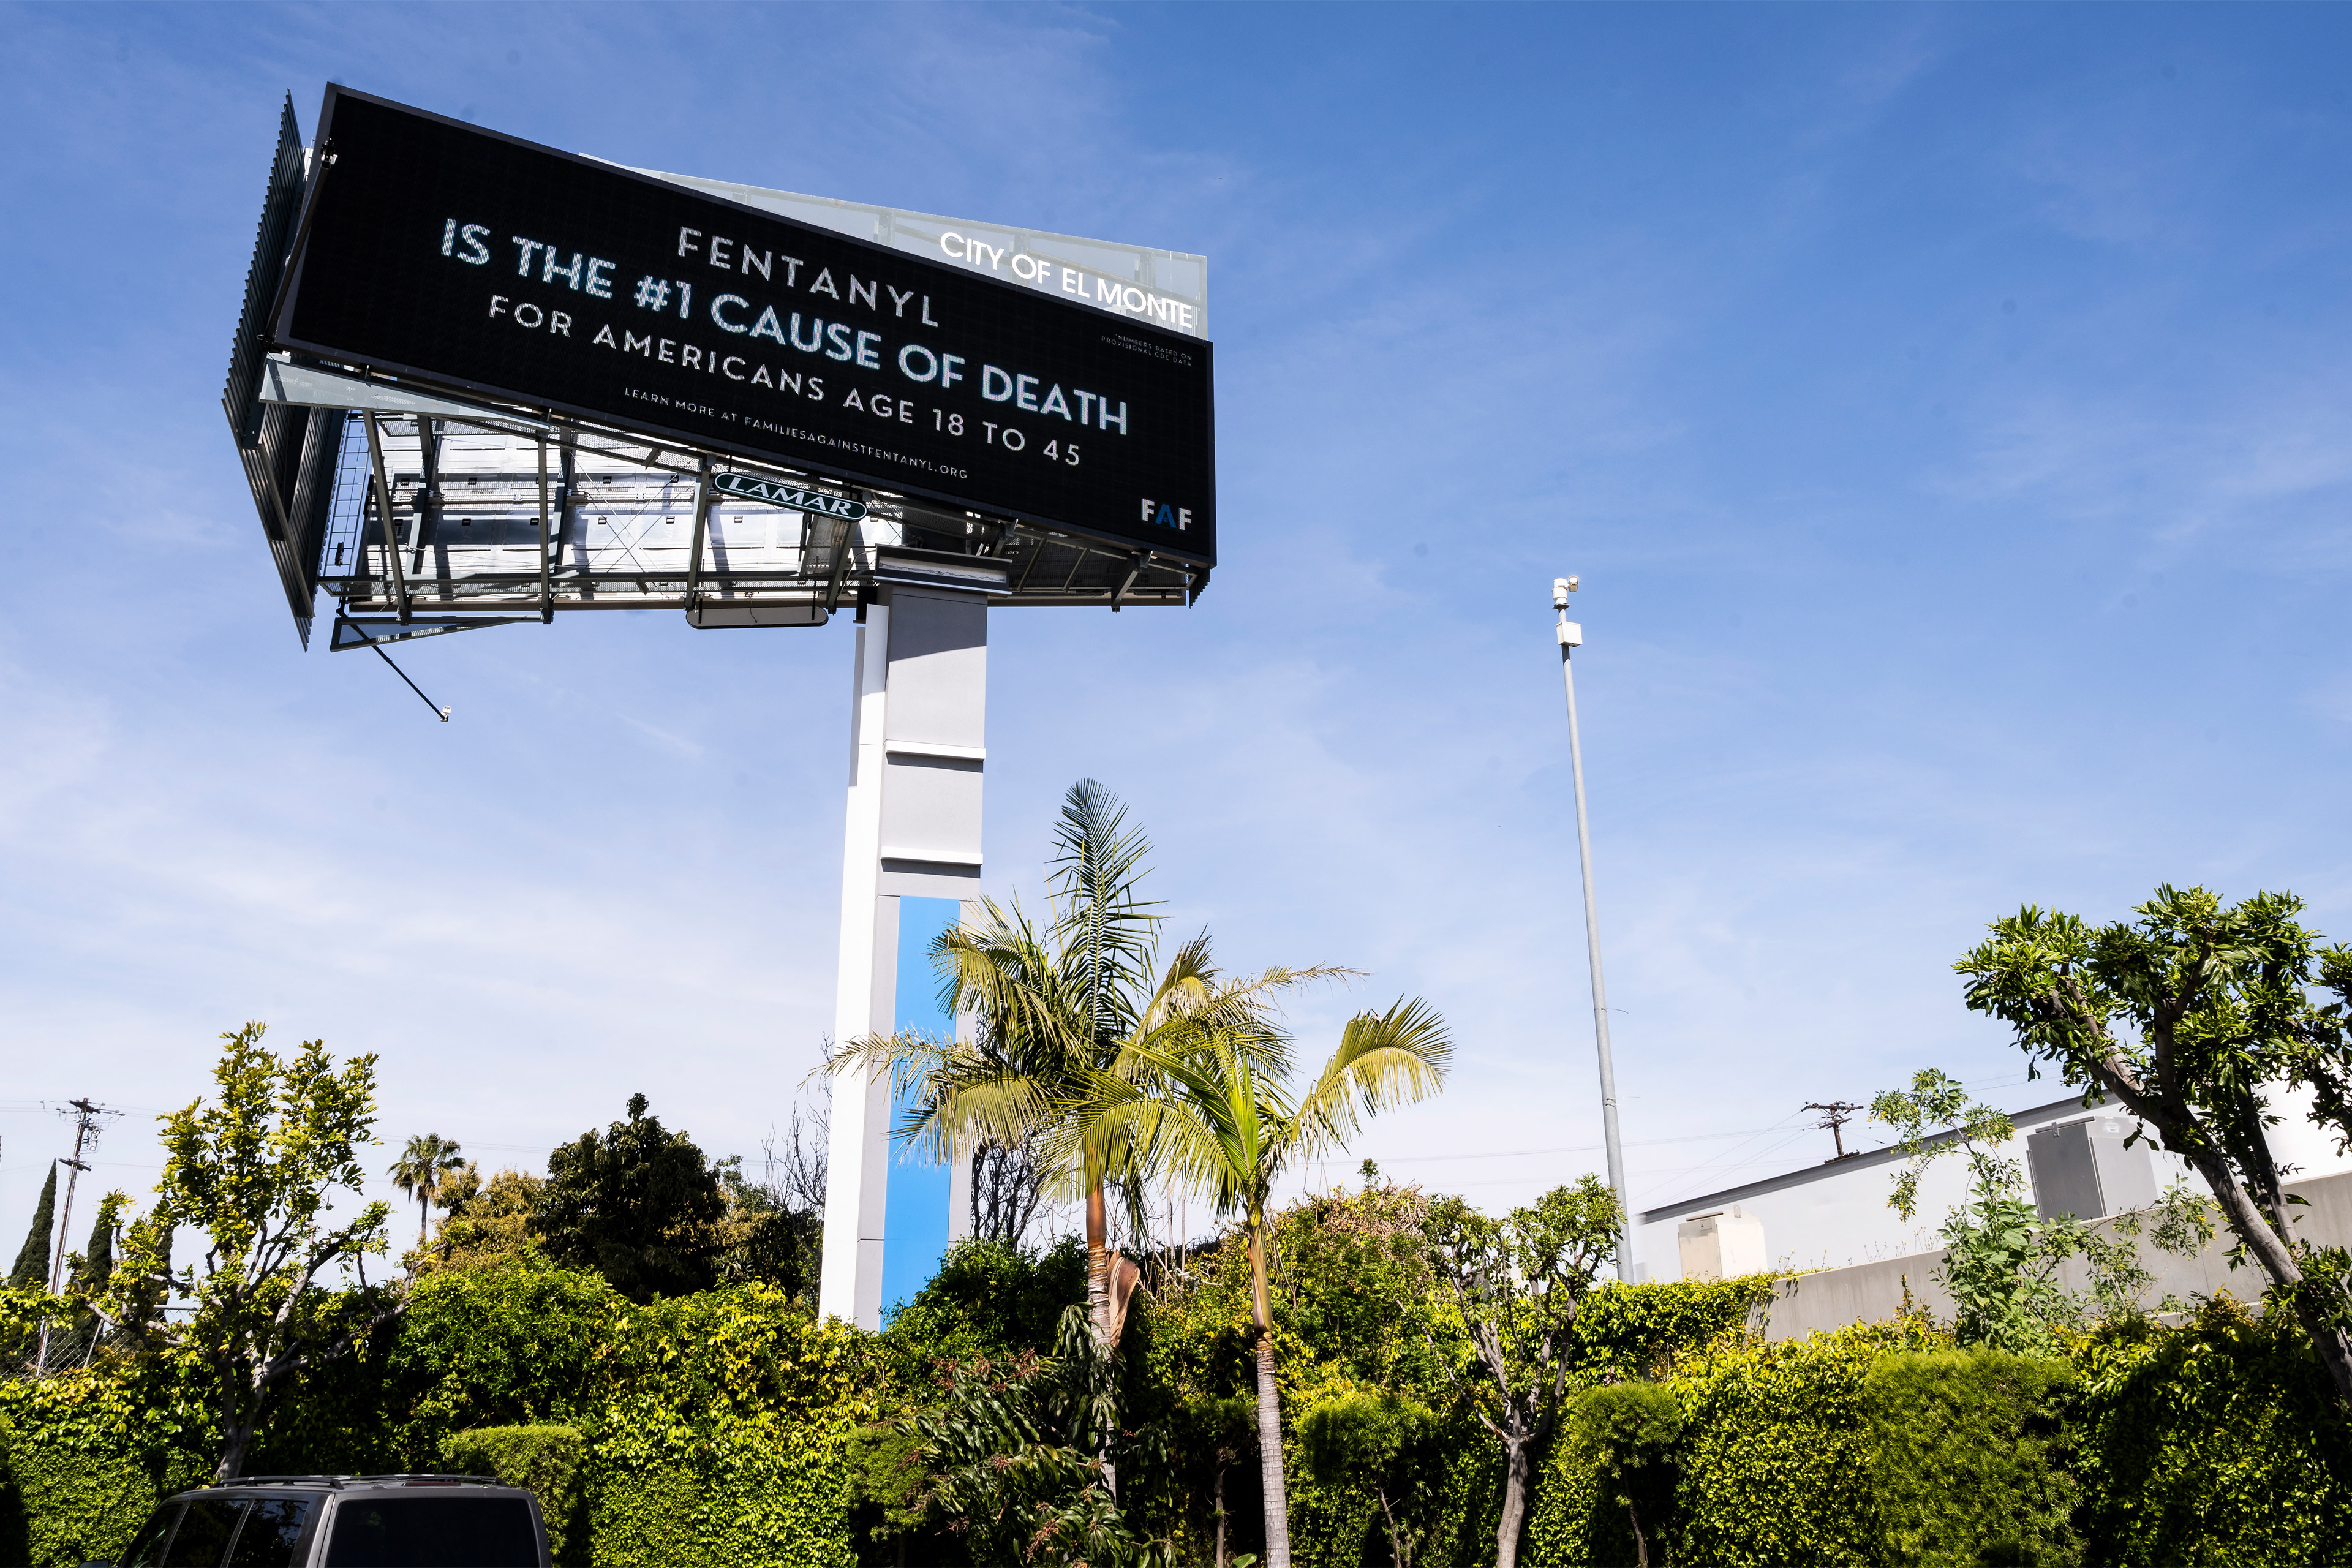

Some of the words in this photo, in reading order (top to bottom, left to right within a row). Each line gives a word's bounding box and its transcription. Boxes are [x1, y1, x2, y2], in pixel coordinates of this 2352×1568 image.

[677, 226, 938, 328] FENTANYL
[940, 232, 1005, 271] CITY
[1011, 254, 1051, 284] OF
[1062, 267, 1090, 298] EL
[1098, 277, 1192, 328] MONTE
[441, 218, 491, 265] IS
[512, 236, 616, 300] THE
[633, 274, 692, 319] #1
[710, 293, 881, 370] CAUSE
[897, 344, 966, 388] OF
[982, 364, 1127, 435] DEATH
[1101, 336, 1152, 355] PROVISIONAL
[1155, 352, 1170, 361] CDC
[1173, 357, 1192, 366] DATA
[1155, 345, 1178, 356] BASED
[488, 294, 572, 337] FOR
[592, 323, 824, 401] AMERICANS
[842, 387, 914, 424] AGE
[932, 408, 964, 436] 18
[982, 421, 1025, 451] TO
[1043, 439, 1080, 466] 45
[625, 387, 669, 405] LEARN
[675, 399, 715, 417] MORE
[721, 411, 737, 421] AT
[744, 417, 968, 479] FAMILIESAGAINSTFENTANYL.ORG
[728, 477, 851, 515] LAMAR
[1141, 498, 1192, 530] FAF
